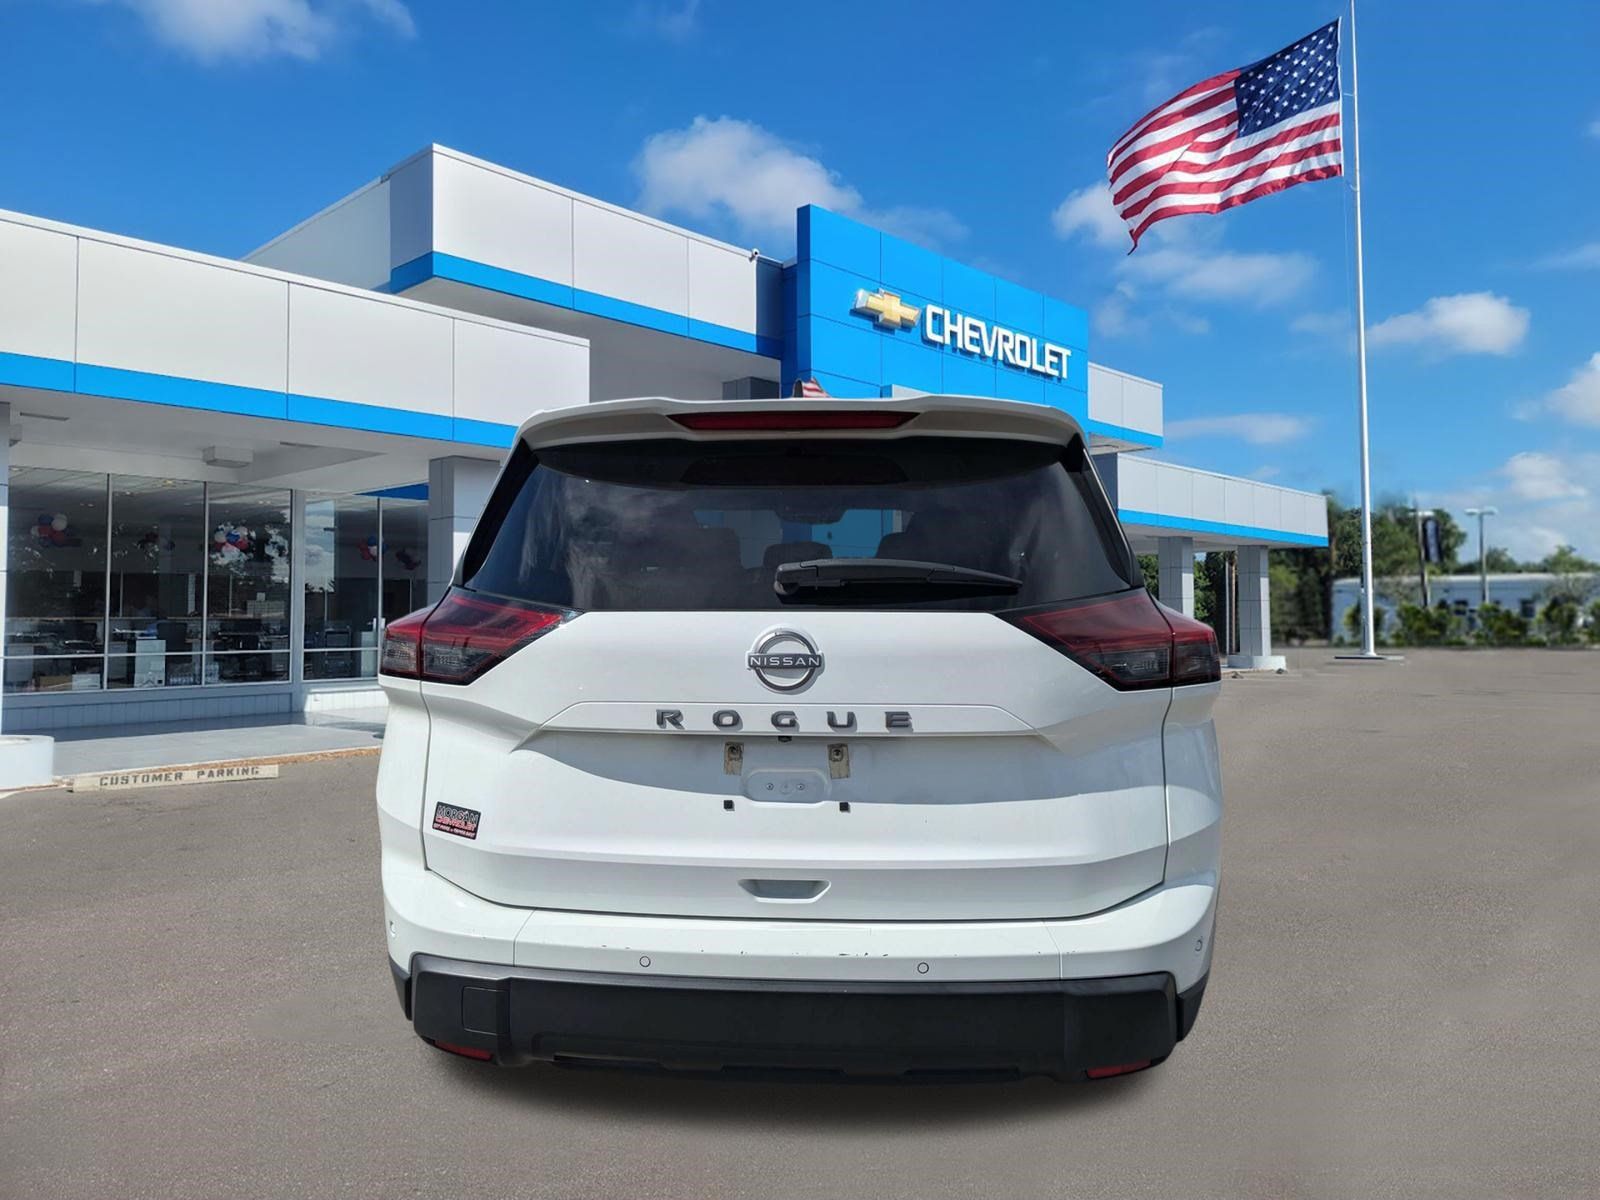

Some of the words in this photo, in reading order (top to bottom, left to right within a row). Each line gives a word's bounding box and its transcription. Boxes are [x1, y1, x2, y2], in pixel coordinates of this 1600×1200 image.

[925, 303, 1072, 379] CHEVROLET
[750, 656, 820, 666] NISSAN
[655, 709, 912, 729] ROGUE
[99, 771, 184, 787] CUSTOMER
[196, 766, 260, 779] PARKING
[436, 805, 479, 825] MORGAN
